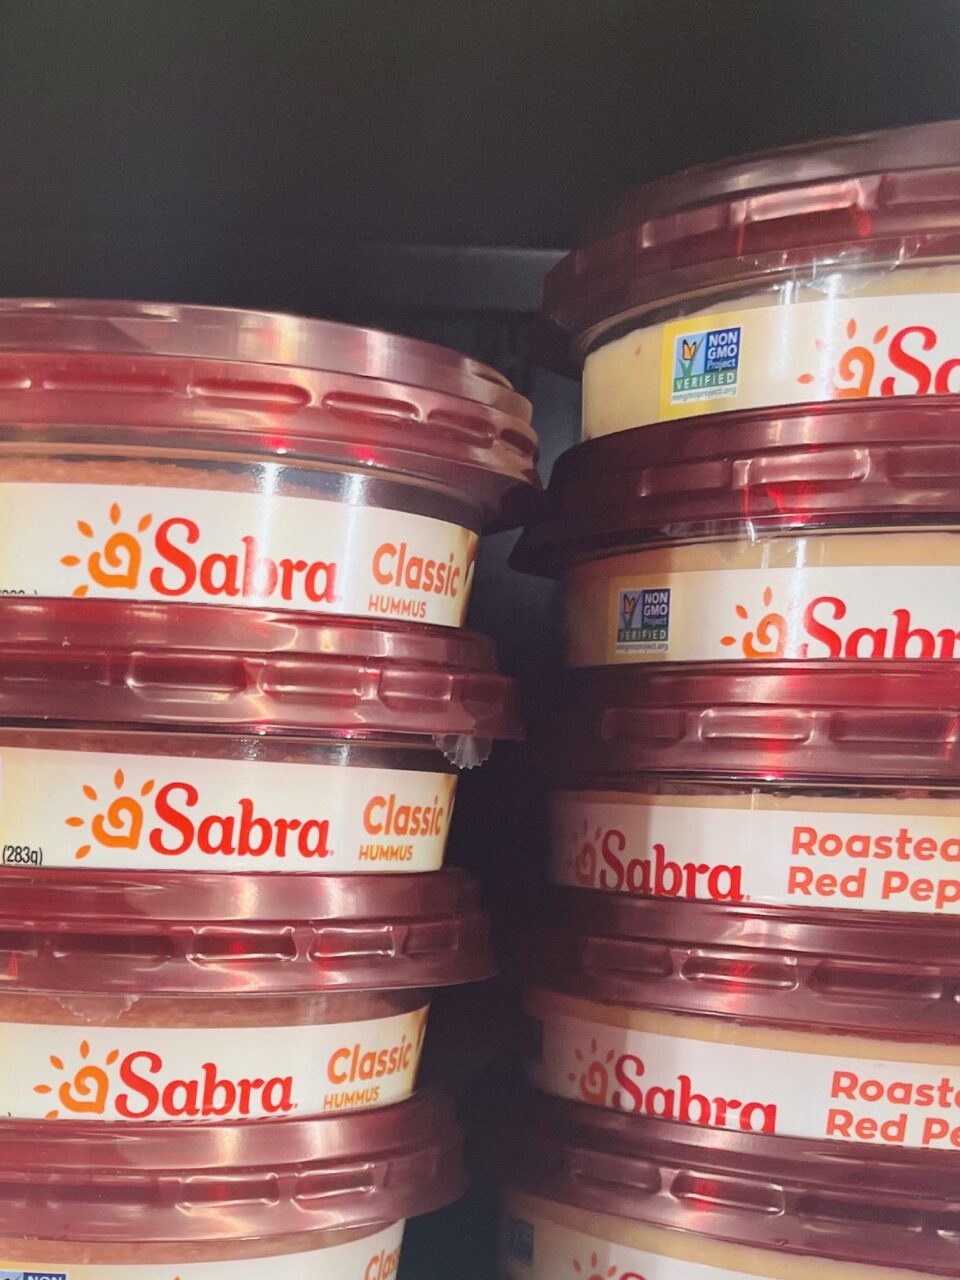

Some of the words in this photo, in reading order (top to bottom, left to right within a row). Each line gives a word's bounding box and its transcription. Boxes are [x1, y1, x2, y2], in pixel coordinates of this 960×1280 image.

[708, 345, 737, 359] GMO
[709, 331, 738, 347] NON
[676, 372, 735, 390] VERIFIED
[149, 516, 338, 603] Sabra
[372, 542, 460, 597] Classic
[368, 595, 426, 618] HUMMUS
[644, 592, 668, 604] NON
[149, 782, 330, 858] Sabra
[363, 795, 443, 836] Classic
[2, 845, 43, 866] (283g)
[358, 844, 413, 861] HUMMUS
[600, 829, 745, 901] Sabra
[787, 866, 866, 898] Red
[327, 1036, 412, 1084] Classic
[114, 1051, 293, 1118] Sabra
[323, 1086, 379, 1110] HUMMUS
[612, 1054, 778, 1134] Sabra
[826, 1108, 907, 1142] Red
